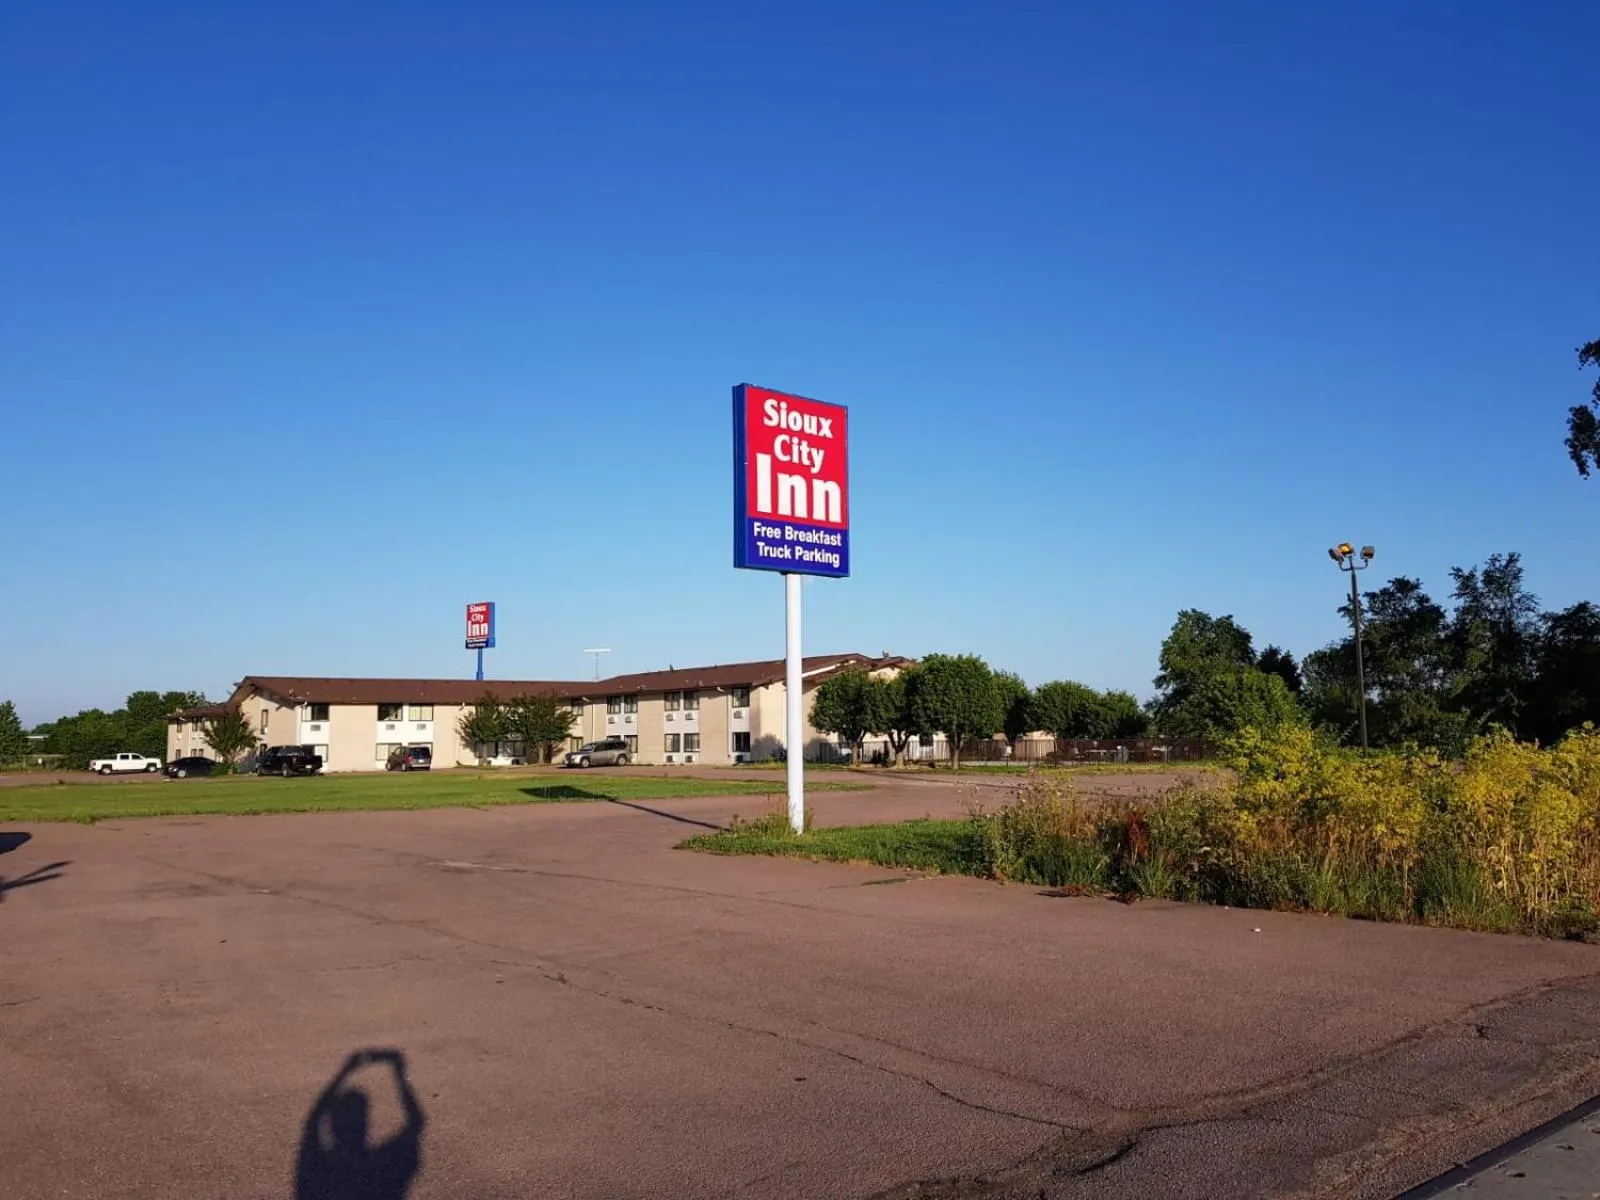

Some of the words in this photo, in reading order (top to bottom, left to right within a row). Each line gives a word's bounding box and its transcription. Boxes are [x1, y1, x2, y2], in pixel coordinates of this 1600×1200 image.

[763, 399, 833, 438] Sioux
[774, 434, 825, 474] City
[756, 453, 842, 523] Inn
[753, 522, 781, 539] Free
[785, 526, 842, 546] Breakfast
[757, 542, 791, 559] Truck
[795, 546, 839, 567] Parking
[467, 620, 488, 637] Inn
[471, 613, 484, 622] City
